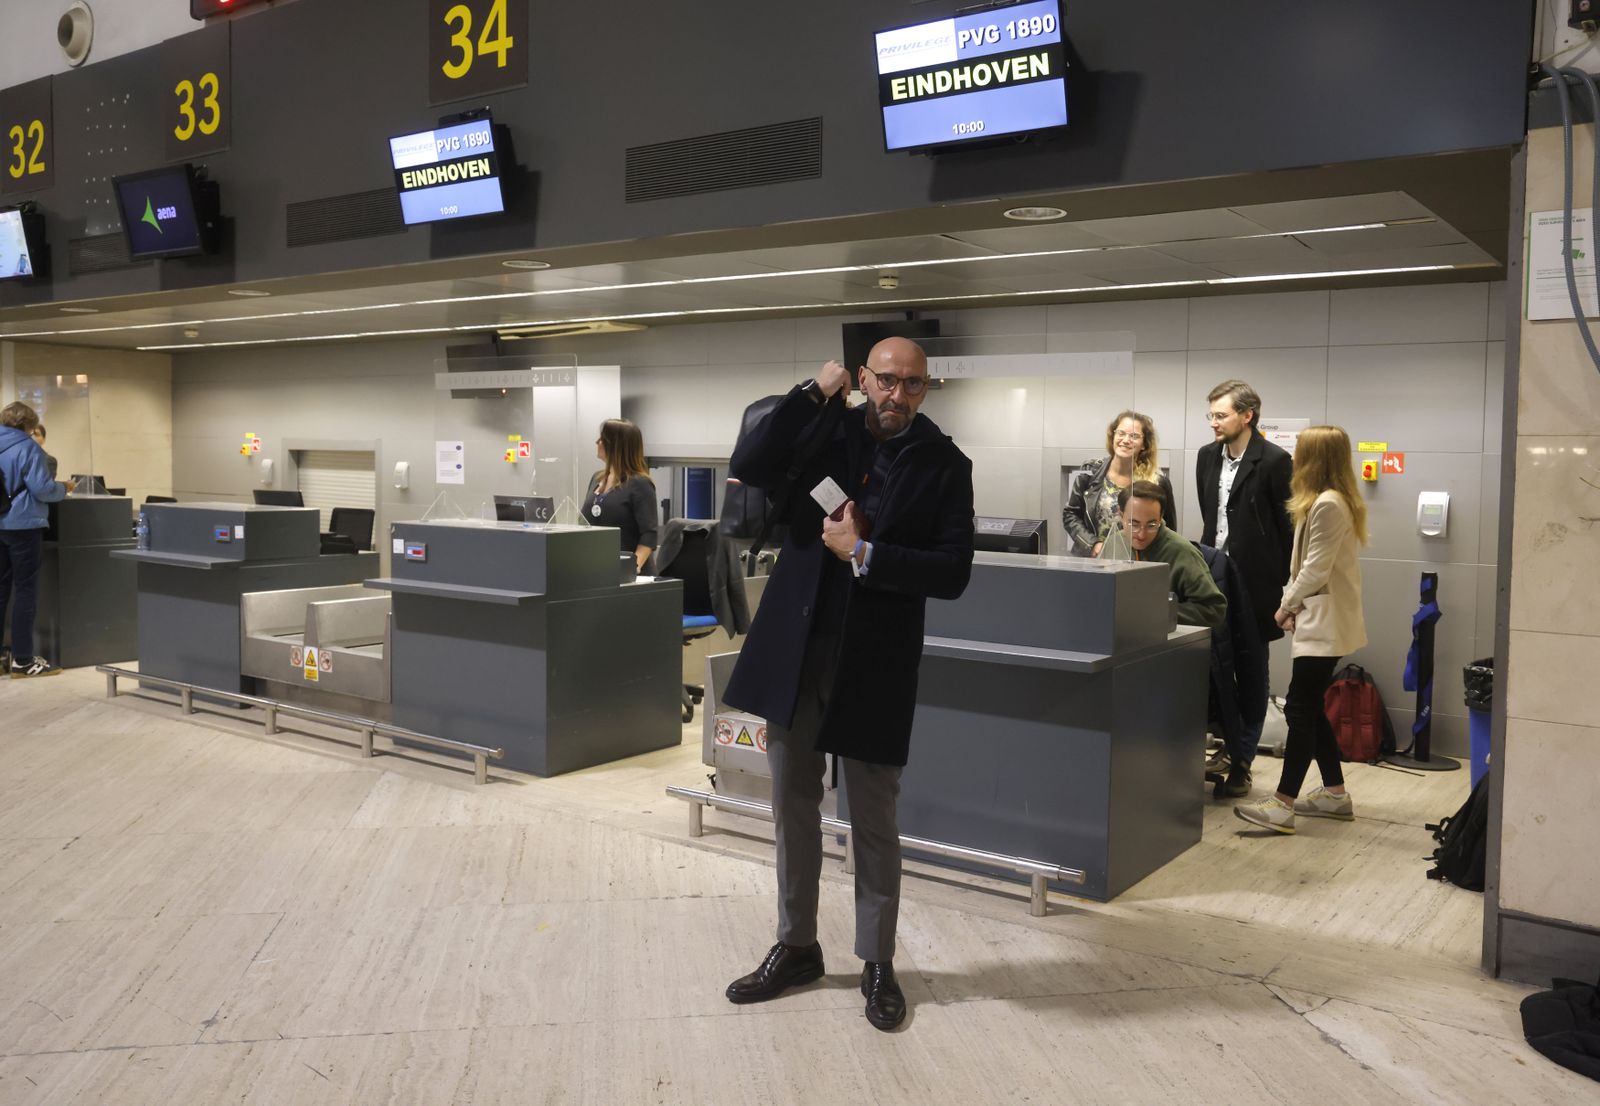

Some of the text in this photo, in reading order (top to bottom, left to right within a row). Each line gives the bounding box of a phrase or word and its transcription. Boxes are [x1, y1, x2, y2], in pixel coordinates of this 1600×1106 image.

[442, 0, 513, 79] 34
[879, 35, 952, 55] PRIVILEGE
[958, 13, 1057, 49] PVG 1890
[890, 52, 1051, 101] EINDHOVEN
[173, 72, 221, 142] 33
[437, 131, 491, 153] PVG 1890
[952, 120, 985, 135] 10:00
[8, 119, 46, 179] 32
[402, 158, 491, 189] EINDHOVEN
[156, 205, 177, 220] aena
[440, 205, 458, 216] 10:00
